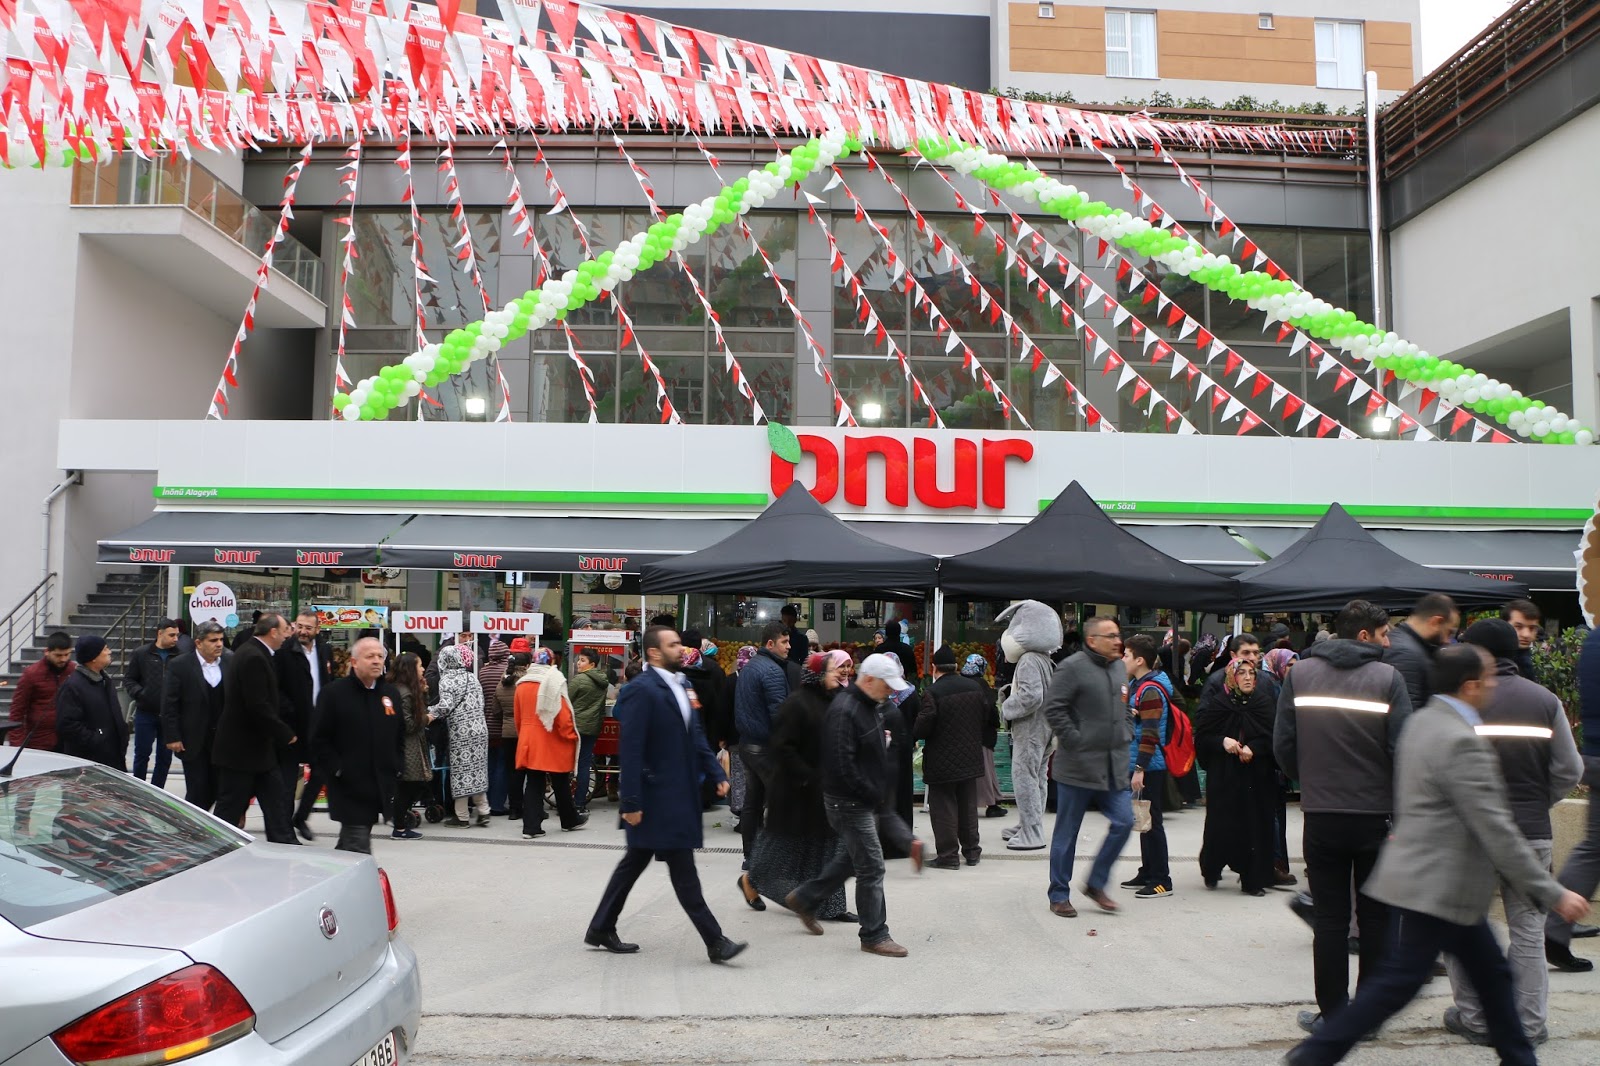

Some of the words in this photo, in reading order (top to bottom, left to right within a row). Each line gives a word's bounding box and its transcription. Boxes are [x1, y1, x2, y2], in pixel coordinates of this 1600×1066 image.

[546, 4, 565, 14] onur
[160, 14, 178, 28] nur
[340, 15, 361, 28] onur
[421, 35, 442, 49] onur
[488, 45, 505, 57] onur
[10, 66, 31, 78] onur
[769, 430, 1034, 509] onur
[185, 488, 218, 498] Alageyik
[1116, 502, 1137, 510] Sözü
[129, 547, 176, 563] onur
[214, 548, 261, 564] onur
[296, 549, 343, 565] onur
[453, 552, 503, 568] onur
[578, 554, 628, 571] onur
[191, 596, 234, 608] chokella
[404, 613, 448, 630] onur
[483, 614, 530, 632] onur
